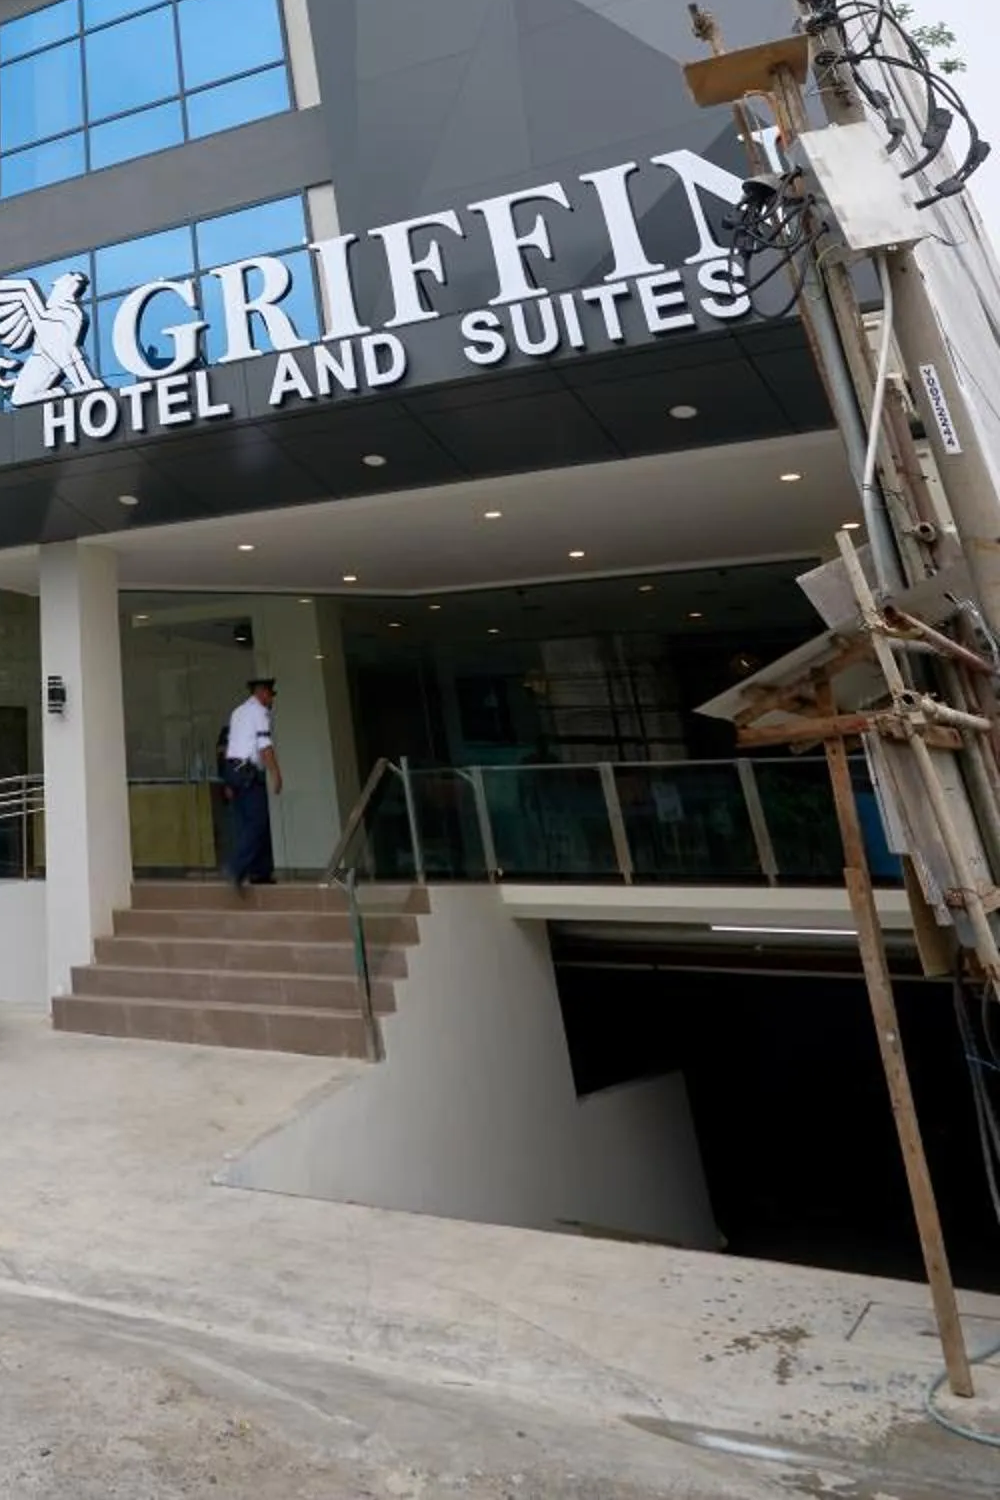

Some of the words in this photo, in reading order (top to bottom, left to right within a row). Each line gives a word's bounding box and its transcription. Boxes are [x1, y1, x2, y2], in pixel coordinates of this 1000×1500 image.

[42, 370, 231, 448] HOTEL
[269, 336, 409, 406] AND
[462, 258, 752, 367] SUITES
[112, 124, 790, 378] GRIFFIN
